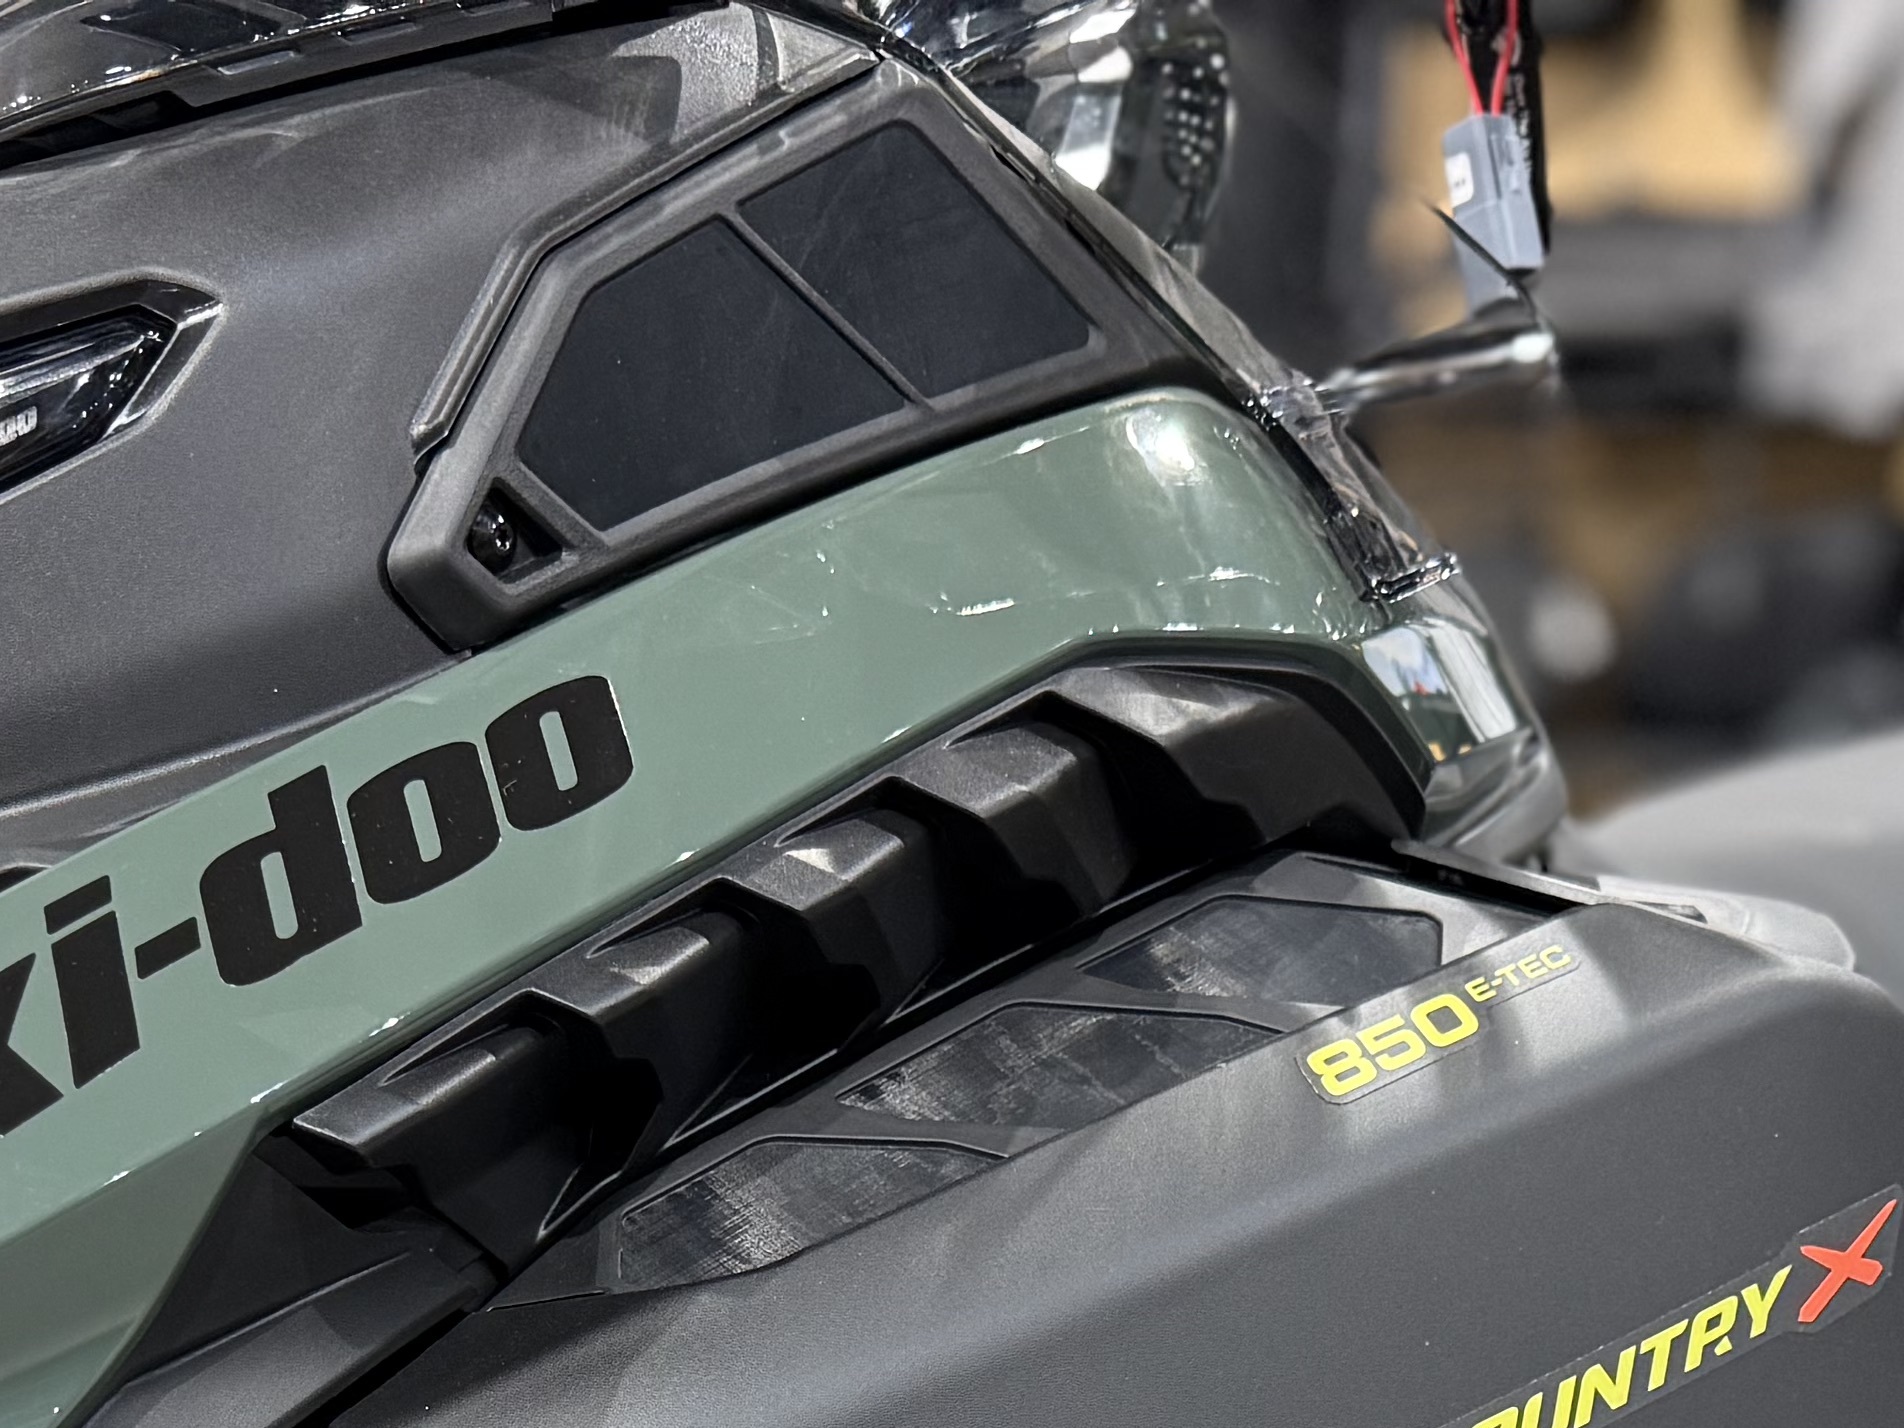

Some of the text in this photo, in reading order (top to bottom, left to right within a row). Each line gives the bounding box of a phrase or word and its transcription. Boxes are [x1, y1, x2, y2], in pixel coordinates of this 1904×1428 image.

[1306, 944, 1572, 1097] 850 E-TEC
[1799, 1199, 1898, 1324] X
